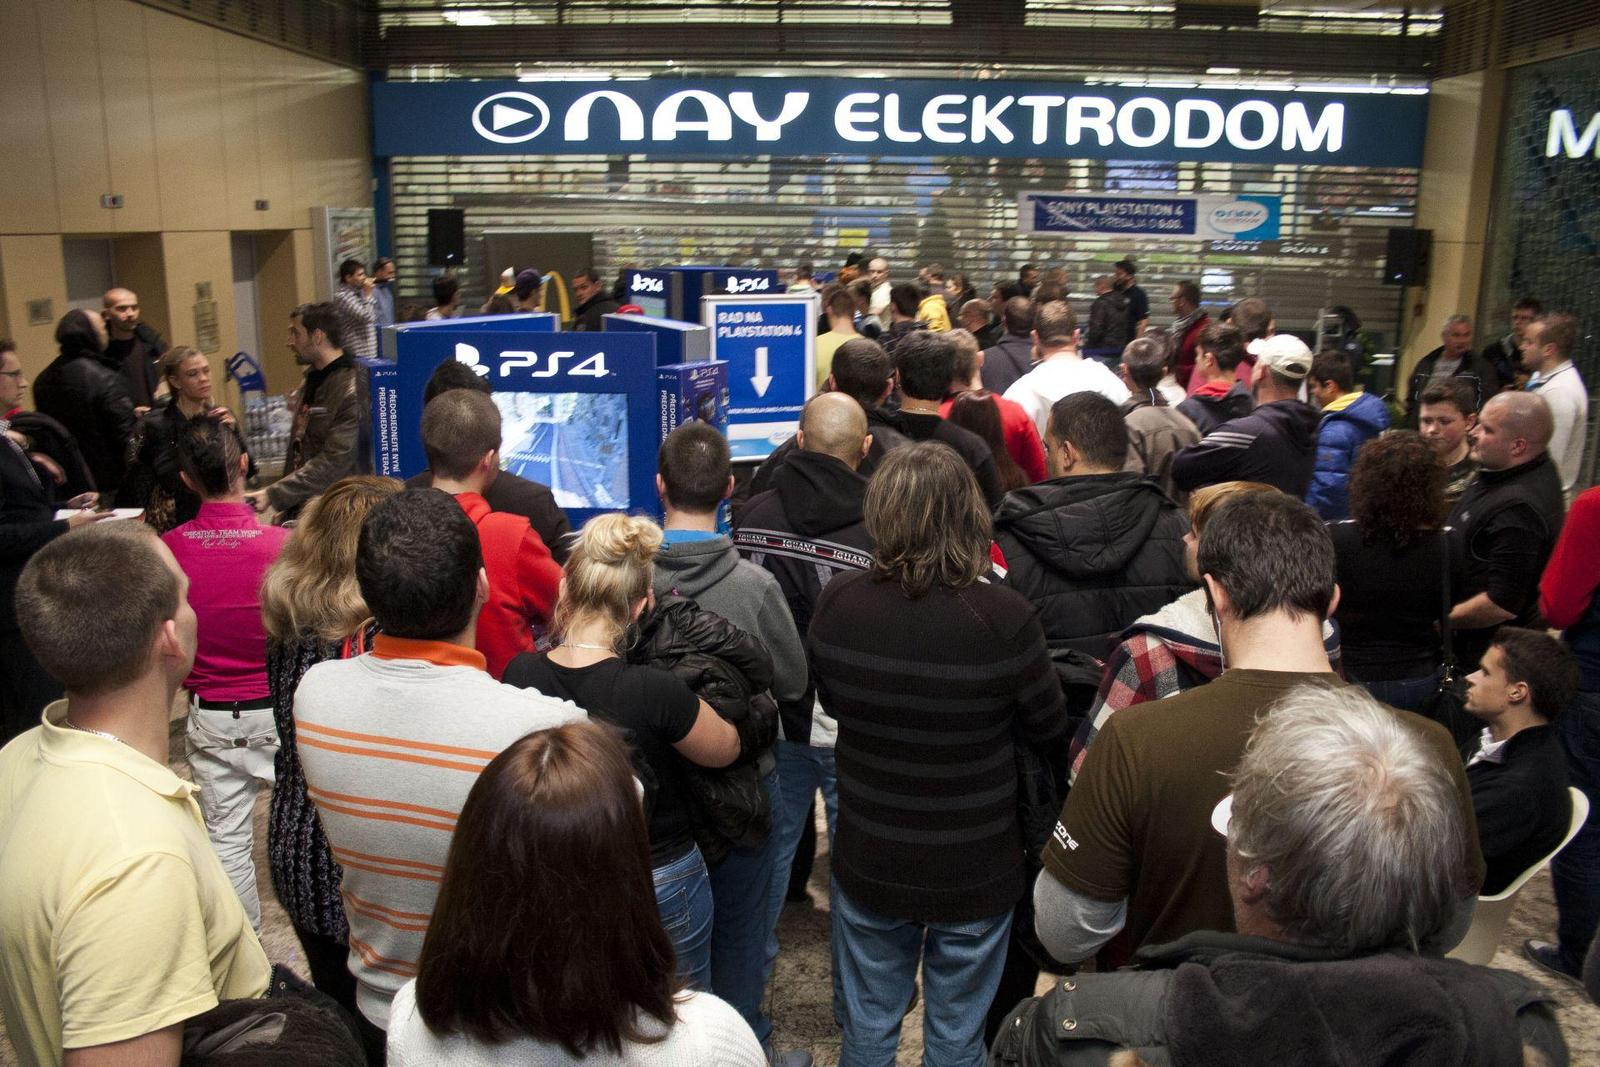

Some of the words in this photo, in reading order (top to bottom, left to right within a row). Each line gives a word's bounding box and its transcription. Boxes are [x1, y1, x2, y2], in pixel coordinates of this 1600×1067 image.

[564, 90, 810, 141] NAY
[834, 92, 1345, 153] ELEKTRODOM
[1047, 201, 1083, 213] SONY
[1084, 202, 1174, 216] PLAYSTATION
[1175, 204, 1184, 216] 4
[745, 311, 764, 322] NA
[718, 325, 794, 338] PLAYSTATION
[795, 325, 803, 336] 4
[500, 350, 610, 378] PS4
[737, 534, 768, 544] IGUANA
[782, 539, 817, 553] IGUANA
[832, 550, 871, 567] IGUANA
